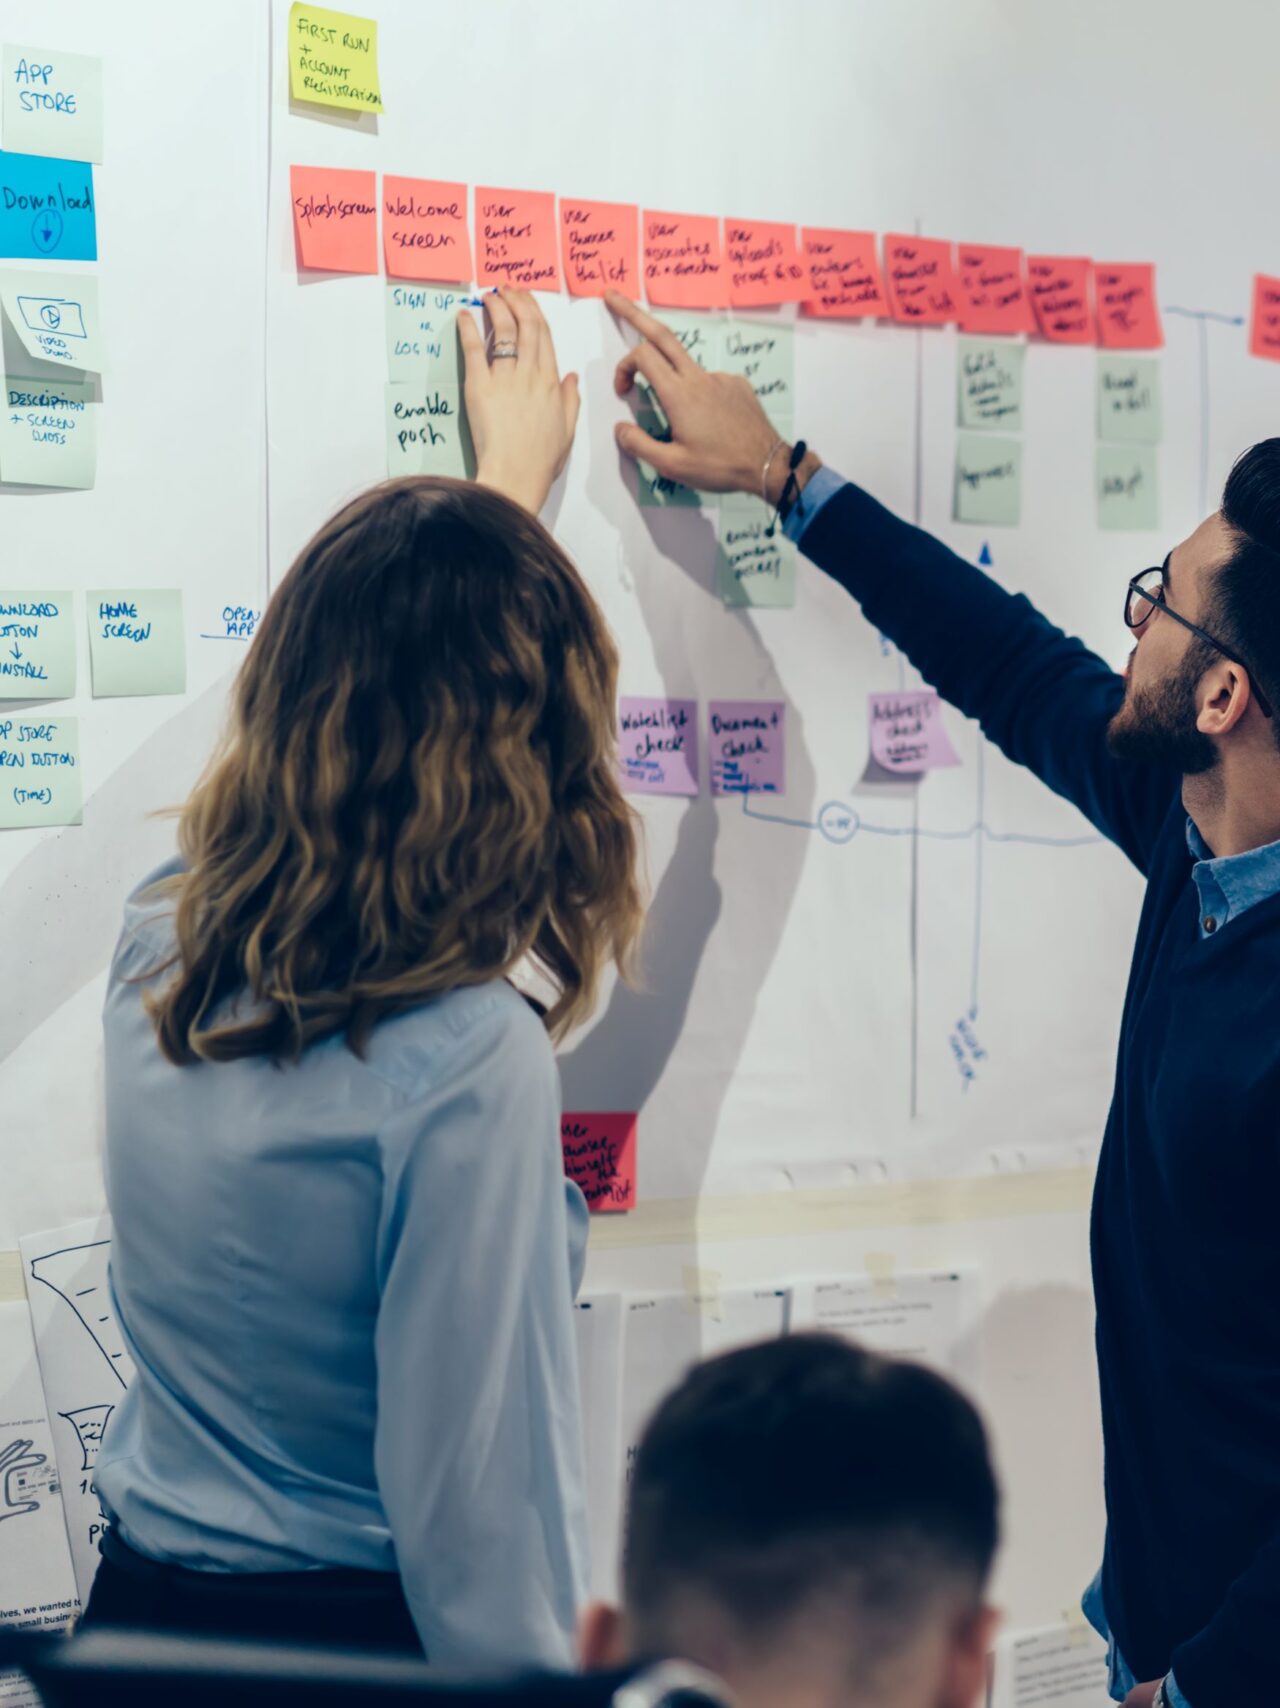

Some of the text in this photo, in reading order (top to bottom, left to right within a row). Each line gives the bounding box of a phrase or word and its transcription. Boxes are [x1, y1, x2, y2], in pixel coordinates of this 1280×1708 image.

[296, 18, 370, 53] FIRST RUN
[14, 58, 53, 85] APP
[299, 56, 351, 80] ACCOUNT
[19, 91, 77, 114] STORE
[2, 182, 93, 213] Download
[394, 289, 454, 310] SIGN UP
[394, 342, 441, 358] LOG IN
[9, 389, 85, 411] DESCRIPTION
[394, 392, 454, 419] enable
[27, 414, 75, 430] SCREEN
[398, 423, 445, 452] push
[0, 602, 58, 617] WNLOAD
[99, 602, 138, 619] HOME
[222, 607, 261, 623] OPEN
[0, 624, 38, 638] UTTON
[103, 622, 151, 642] SCREEN
[17, 724, 58, 742] STORE
[0, 750, 25, 767] PEN
[0, 1609, 21, 1619] lves,
[24, 1606, 37, 1615] we
[39, 1600, 72, 1612] wanted
[18, 1616, 42, 1628] small
